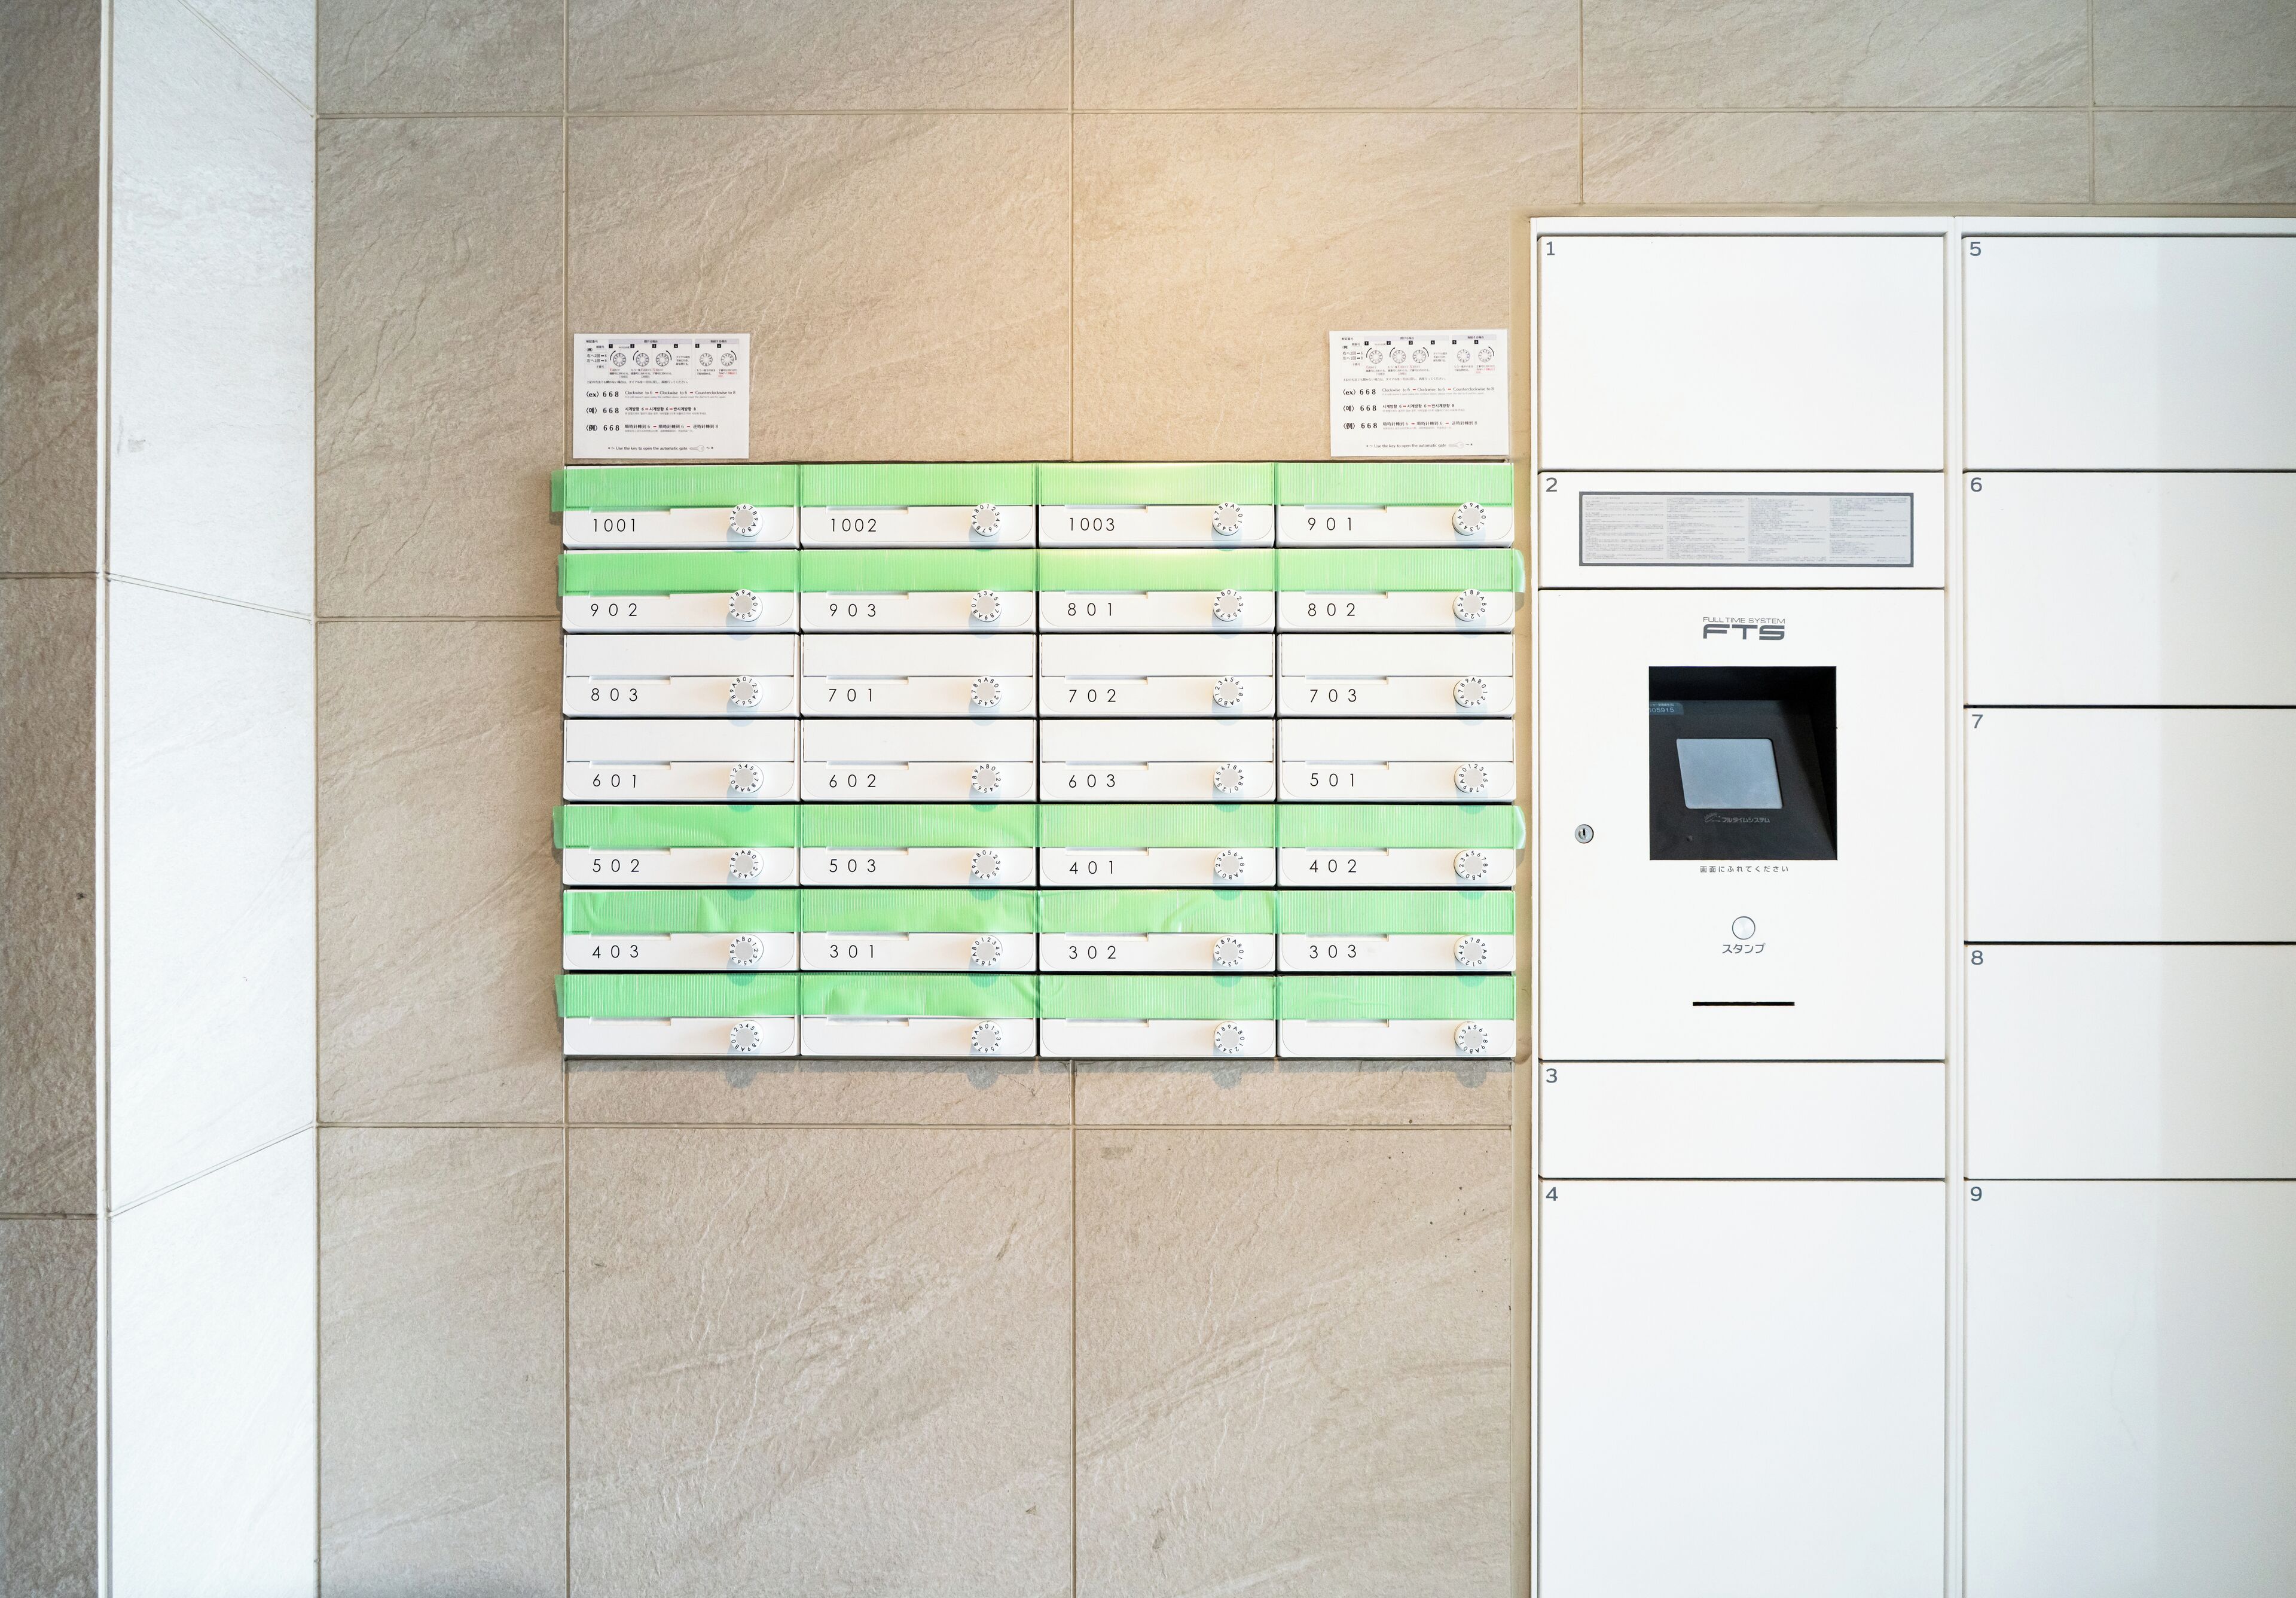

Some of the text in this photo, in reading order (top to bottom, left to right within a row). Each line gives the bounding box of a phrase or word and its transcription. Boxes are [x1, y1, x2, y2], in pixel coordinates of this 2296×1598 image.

[1547, 242, 1555, 255] 1
[1970, 242, 1981, 256] 5
[1546, 477, 1557, 492] 2
[1971, 477, 1982, 492] 6
[594, 519, 634, 532] 1001
[832, 519, 876, 532] 1002
[1070, 518, 1114, 531] 1003
[1703, 624, 1785, 641] FTS
[1972, 714, 1983, 728] 7
[1722, 943, 1766, 953] スタンプ
[1971, 950, 1983, 965] 8
[1546, 1068, 1557, 1083] 3
[1546, 1187, 1558, 1201] 4
[1971, 1187, 1981, 1201] 9
